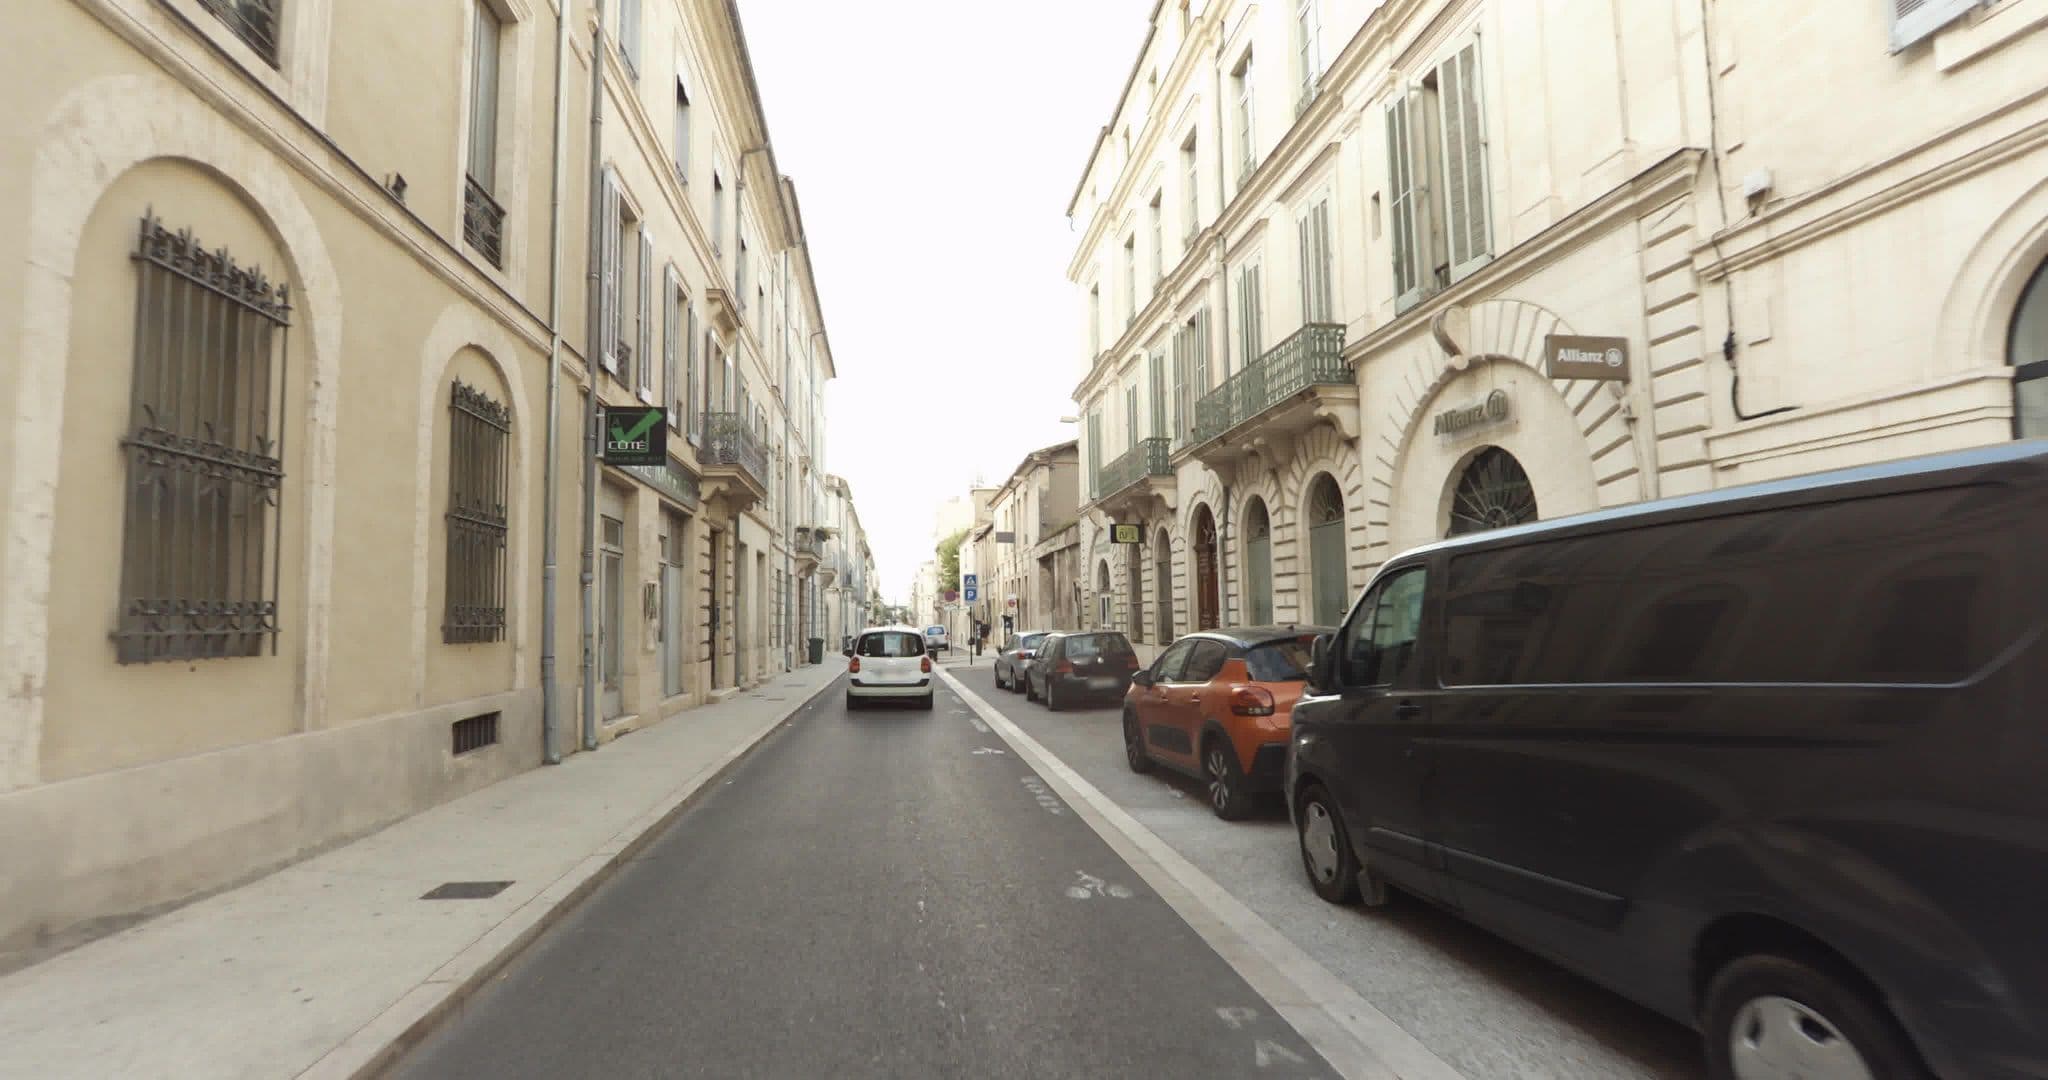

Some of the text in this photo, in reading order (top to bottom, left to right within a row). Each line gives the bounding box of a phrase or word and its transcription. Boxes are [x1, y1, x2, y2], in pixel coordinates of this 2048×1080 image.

[1557, 348, 1604, 363] Allianz
[1433, 404, 1484, 436] Allianz
[607, 439, 649, 450] CÔTÉ
